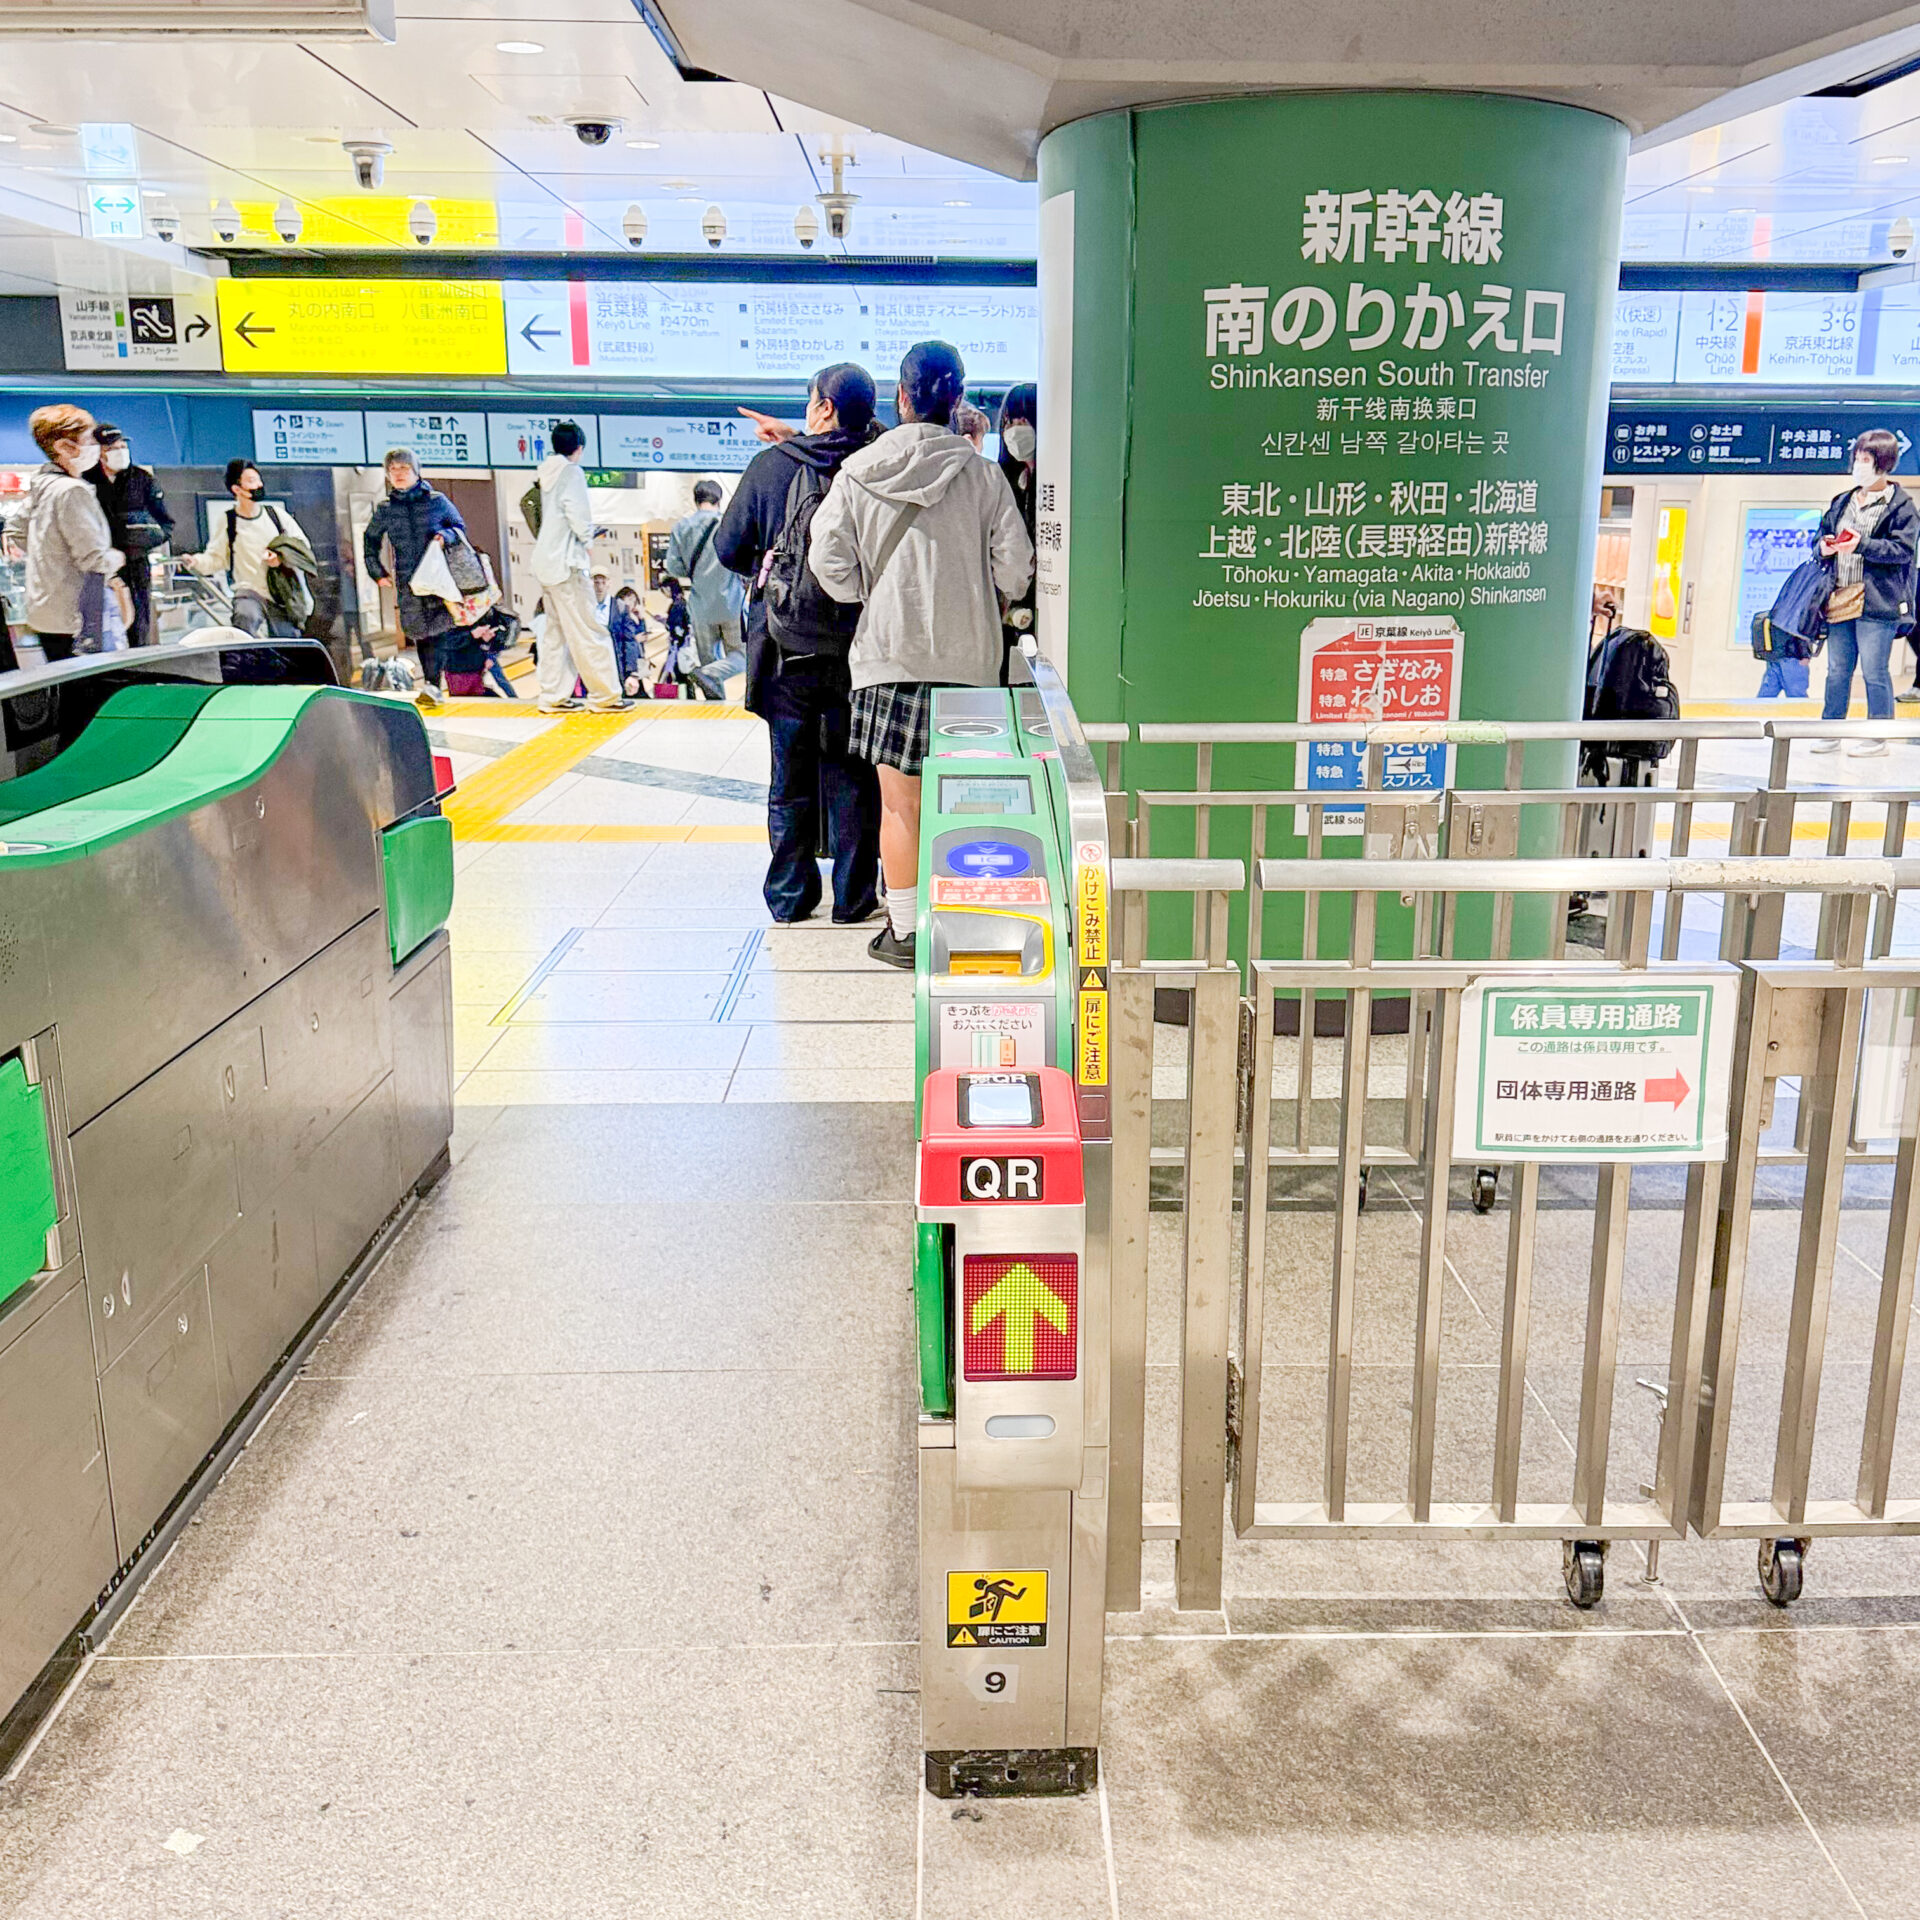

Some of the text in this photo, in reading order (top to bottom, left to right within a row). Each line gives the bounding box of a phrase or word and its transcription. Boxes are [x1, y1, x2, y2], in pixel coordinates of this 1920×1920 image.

[1300, 188, 1504, 265] 新幹線
[75, 299, 111, 312] 山手線
[288, 301, 375, 320] 丸の内南口
[597, 300, 649, 318] 京葉線
[659, 301, 715, 314] ホームまで
[628, 319, 651, 330] Line
[660, 315, 709, 328] 約470m
[1203, 282, 1566, 357] 南のりかえ口
[1632, 327, 1668, 339] (Rapid)
[597, 340, 654, 354] (武蔵野線)
[1695, 335, 1737, 350] 中央線
[1784, 335, 1854, 351] 京浜東北線
[1210, 360, 1550, 390] Shinkansen South Transfer
[1710, 364, 1735, 375] Line
[1827, 366, 1852, 376] Line
[1316, 396, 1477, 421] 新干线南换乘口
[1635, 424, 1668, 437] お弁当
[1710, 424, 1743, 437] お土産
[1261, 430, 1510, 456] 신칸센 남쪽 갈아타는 곳
[1633, 445, 1682, 457] レストラン
[1779, 446, 1843, 460] 北自由通路
[1352, 588, 1386, 612] (via
[1391, 587, 1465, 612] Nagano)
[1470, 584, 1547, 606] Shinkansen
[1360, 627, 1371, 637] JE
[1374, 626, 1408, 638] 京葉線
[1319, 667, 1348, 683] 特急
[1318, 693, 1346, 708] 特急
[1316, 742, 1345, 757] 特急
[1315, 765, 1344, 779] 特急
[1084, 865, 1102, 961] かけこみ禁止
[1510, 1003, 1682, 1031] 係員専用通路
[952, 1018, 1033, 1031] お入れください
[1084, 997, 1102, 1080] 扉にご注意
[1517, 1040, 1667, 1054] この通路は係員専用です。
[1496, 1079, 1638, 1102] 団体専用通路
[1494, 1131, 1690, 1145] 駅員に声をかけて右側の通路をお通りください。
[966, 1158, 1038, 1200] QR
[977, 1625, 1042, 1637] 扉にご注意
[988, 1636, 1031, 1644] CAUTION
[984, 1671, 1007, 1694] 9
